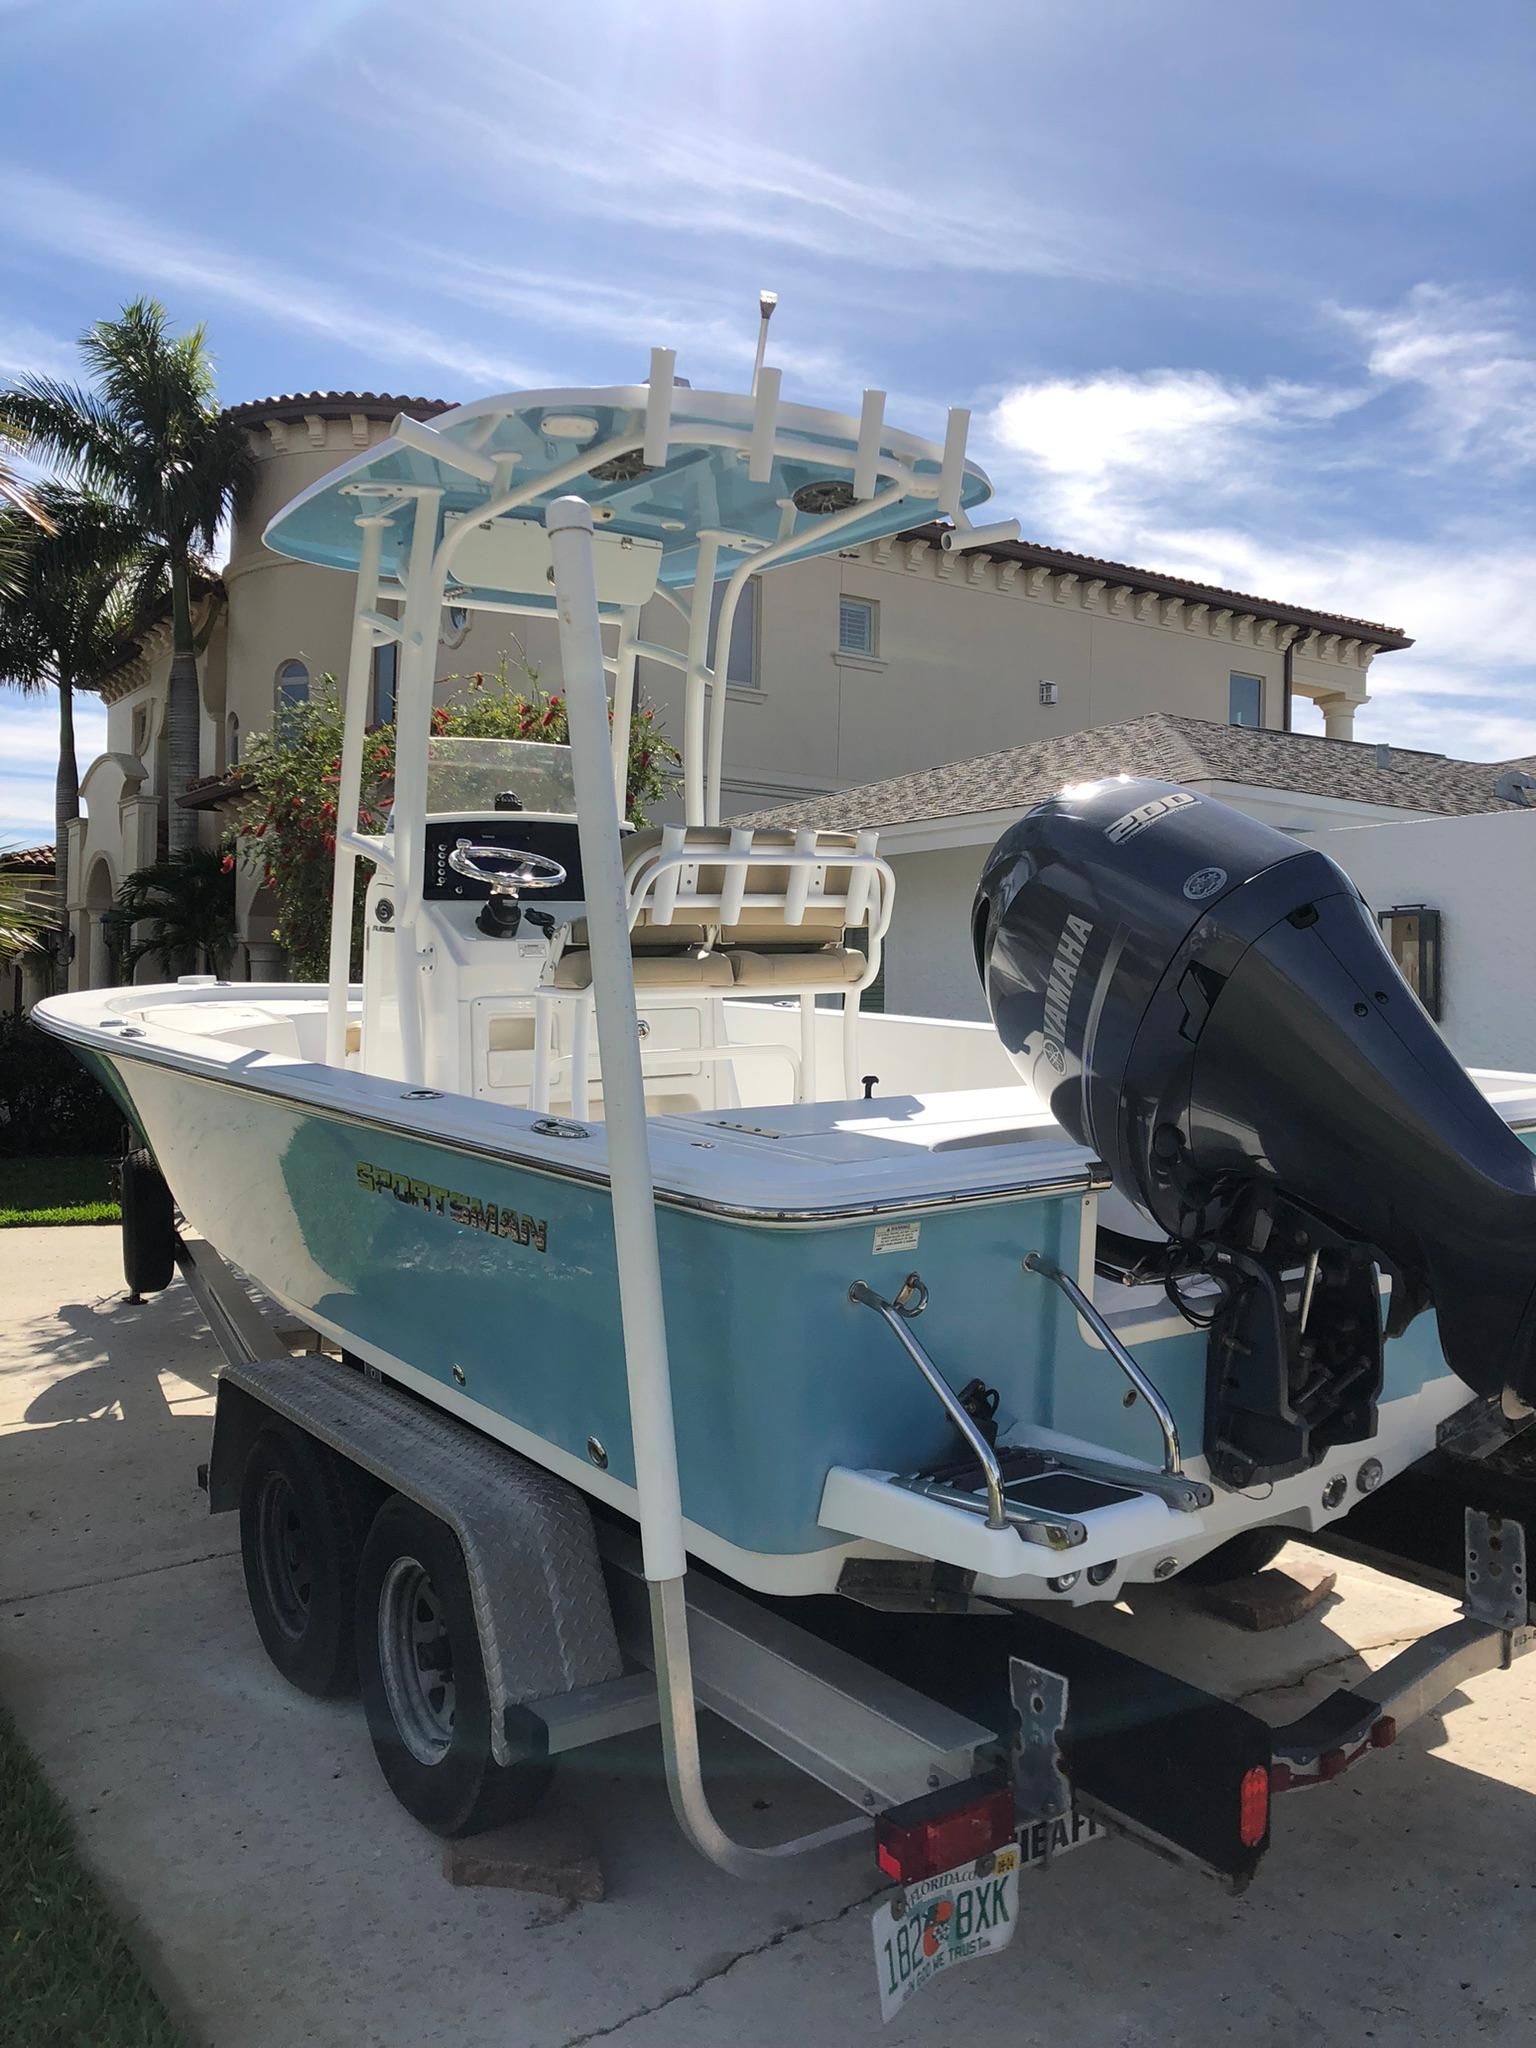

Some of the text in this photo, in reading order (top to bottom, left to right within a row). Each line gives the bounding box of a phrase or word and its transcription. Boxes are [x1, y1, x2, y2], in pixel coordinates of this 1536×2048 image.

[1103, 793, 1198, 845] 200
[1043, 913, 1094, 1044] YAMAHA
[357, 1161, 547, 1253] SPORTSMAN
[884, 1913, 923, 1996] 182
[948, 1937, 983, 1961] TRUST
